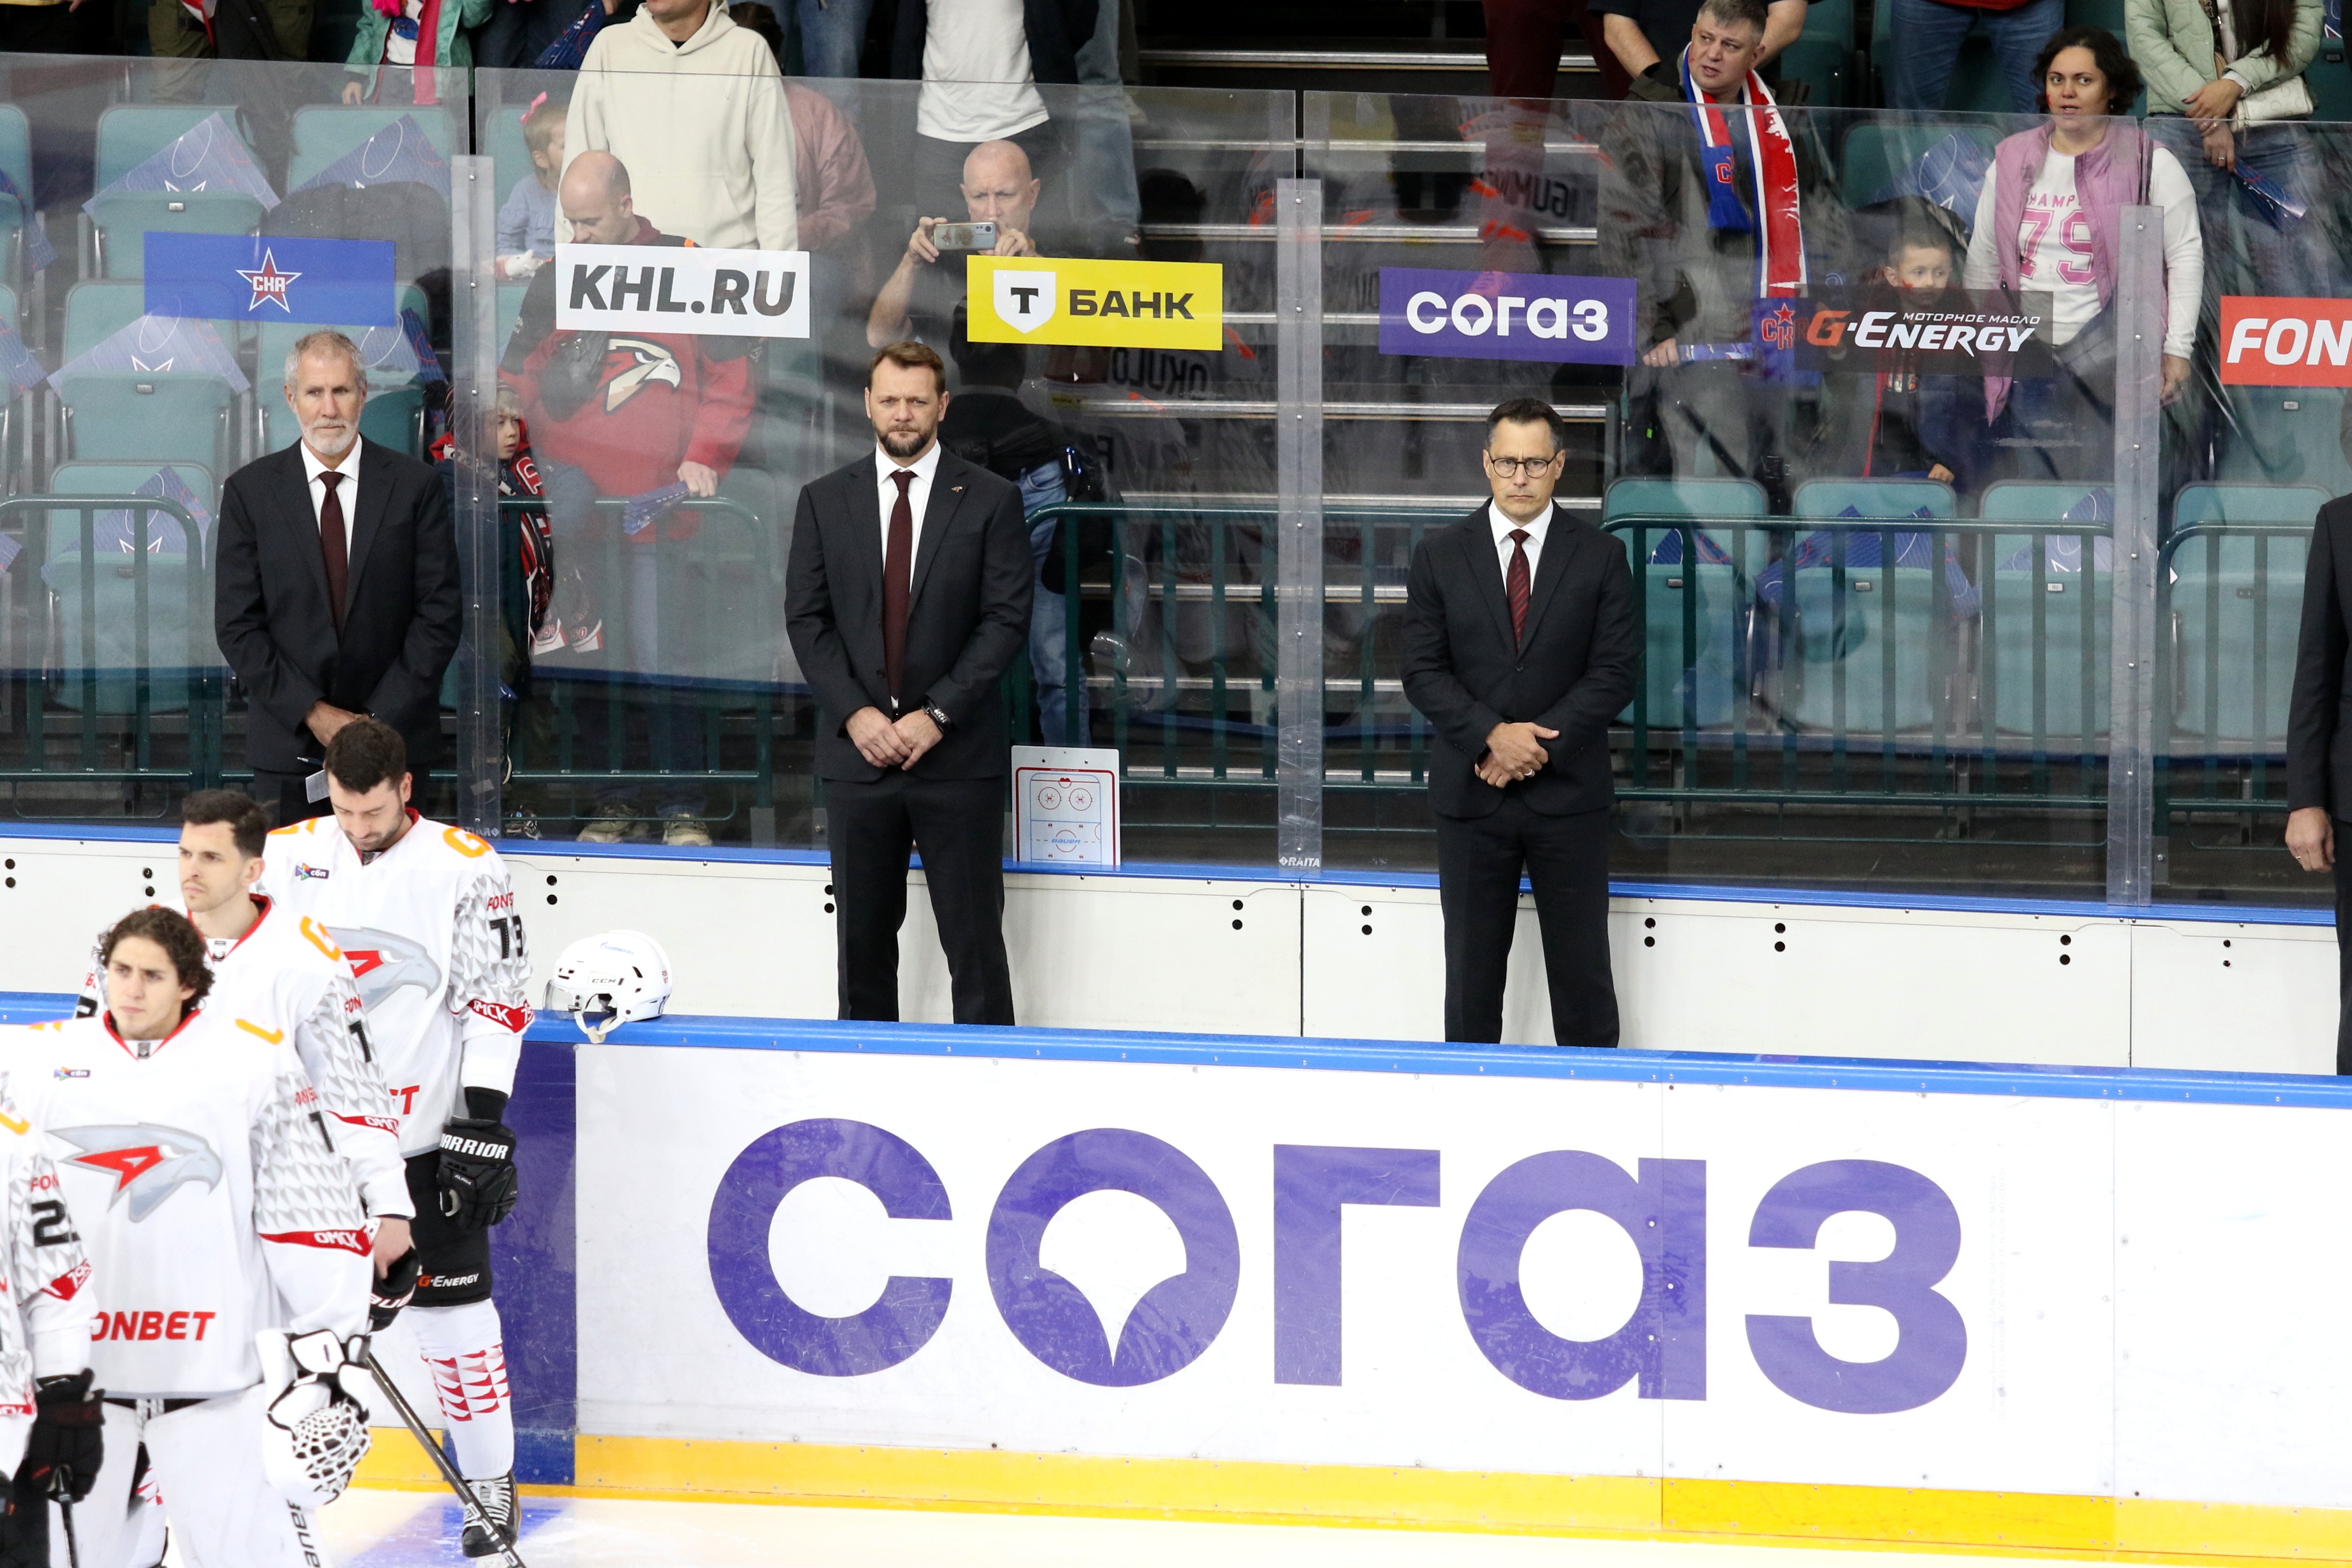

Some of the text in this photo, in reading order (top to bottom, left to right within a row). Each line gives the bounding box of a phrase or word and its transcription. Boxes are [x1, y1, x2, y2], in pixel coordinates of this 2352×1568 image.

[2028, 193, 2081, 207] HAMP
[252, 276, 285, 293] СКА
[569, 264, 796, 316] KHL.RU
[1070, 289, 1195, 320] БАНК
[1903, 312, 2040, 325] МОТОРНОЕ МАСЛО
[1288, 856, 1320, 867] RAITA
